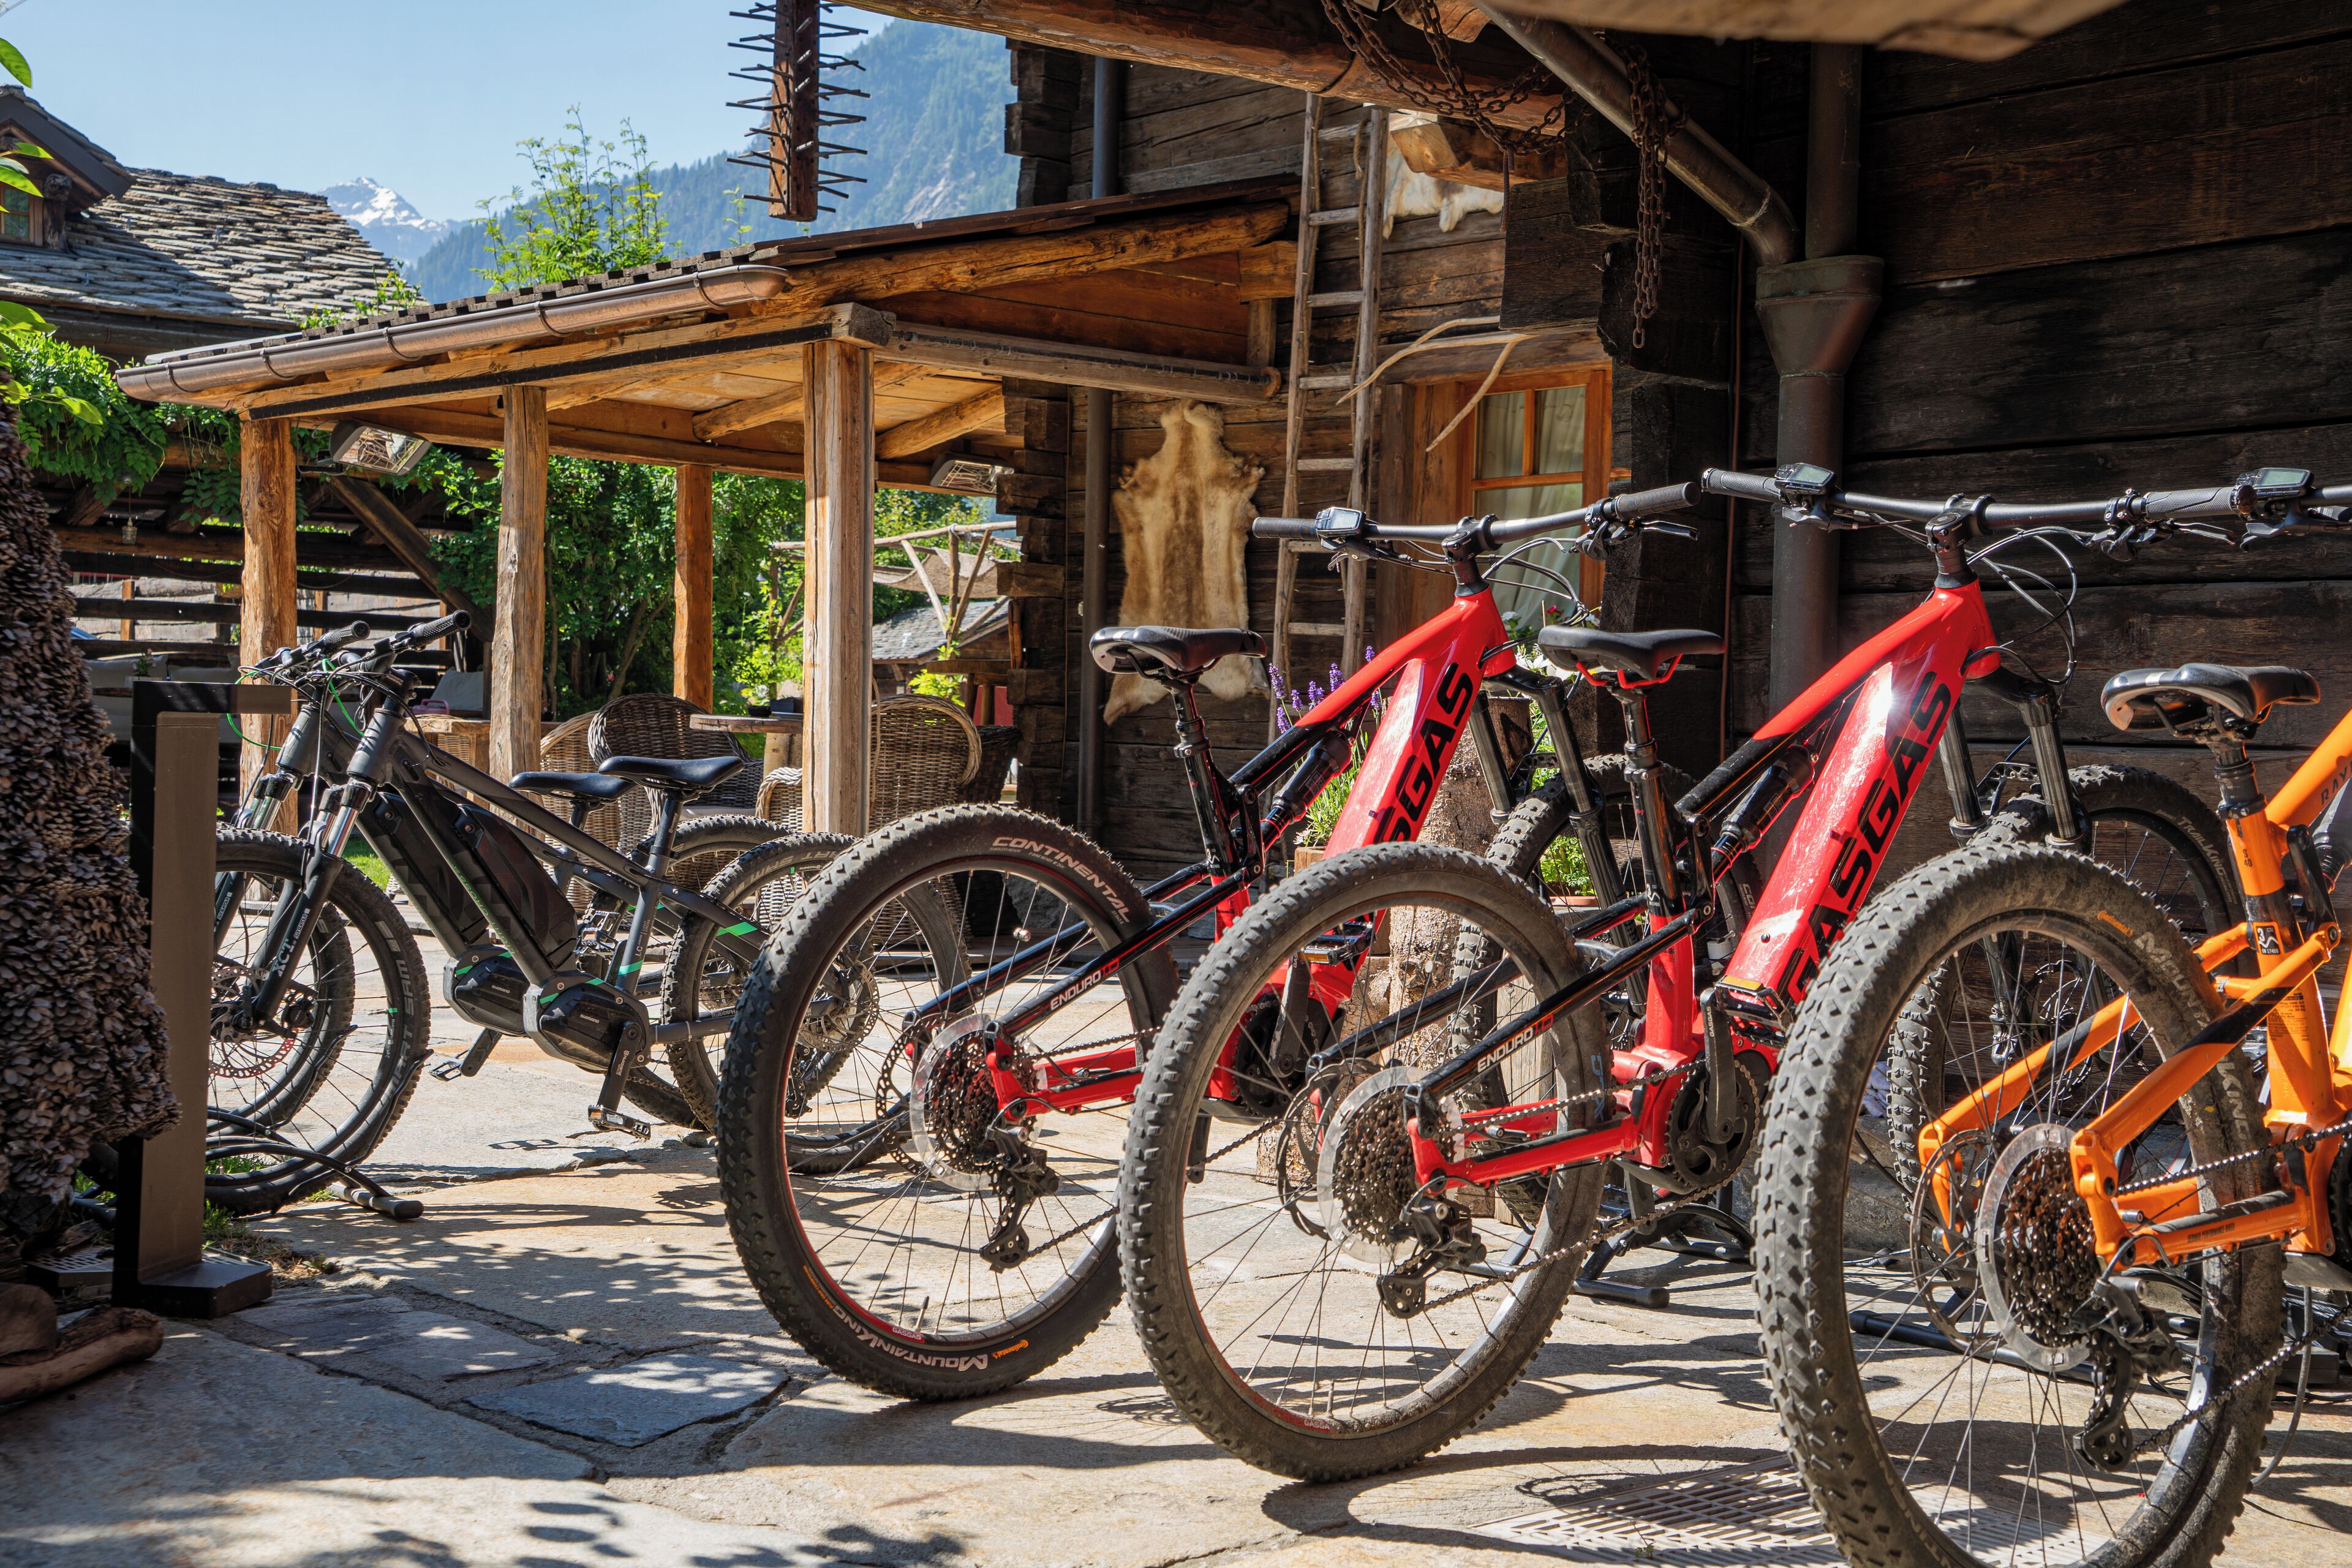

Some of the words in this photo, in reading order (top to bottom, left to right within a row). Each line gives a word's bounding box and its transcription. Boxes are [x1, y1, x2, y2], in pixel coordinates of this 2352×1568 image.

[1374, 663, 1472, 843] SGAS
[2321, 761, 2352, 805] RAY
[992, 837, 1129, 922] CONTINENTAL
[460, 875, 489, 916] CROSS
[491, 921, 516, 954] LIGHT
[2097, 910, 2134, 938] Continental
[2257, 928, 2265, 941] 3
[635, 946, 643, 957] LC
[396, 959, 415, 1016] SAM
[491, 985, 510, 994] SHIMANO
[1050, 970, 1101, 1011] ENDURO
[579, 1014, 600, 1023] SHIMANO
[1478, 1027, 1533, 1073] ENDURO
[617, 1055, 628, 1076] Husqvarna
[833, 1305, 988, 1371] MOUNTAINKING
[892, 1326, 921, 1341] GASGAS
[992, 1340, 1029, 1360] Continental
[1304, 1419, 1330, 1430] GASGA
